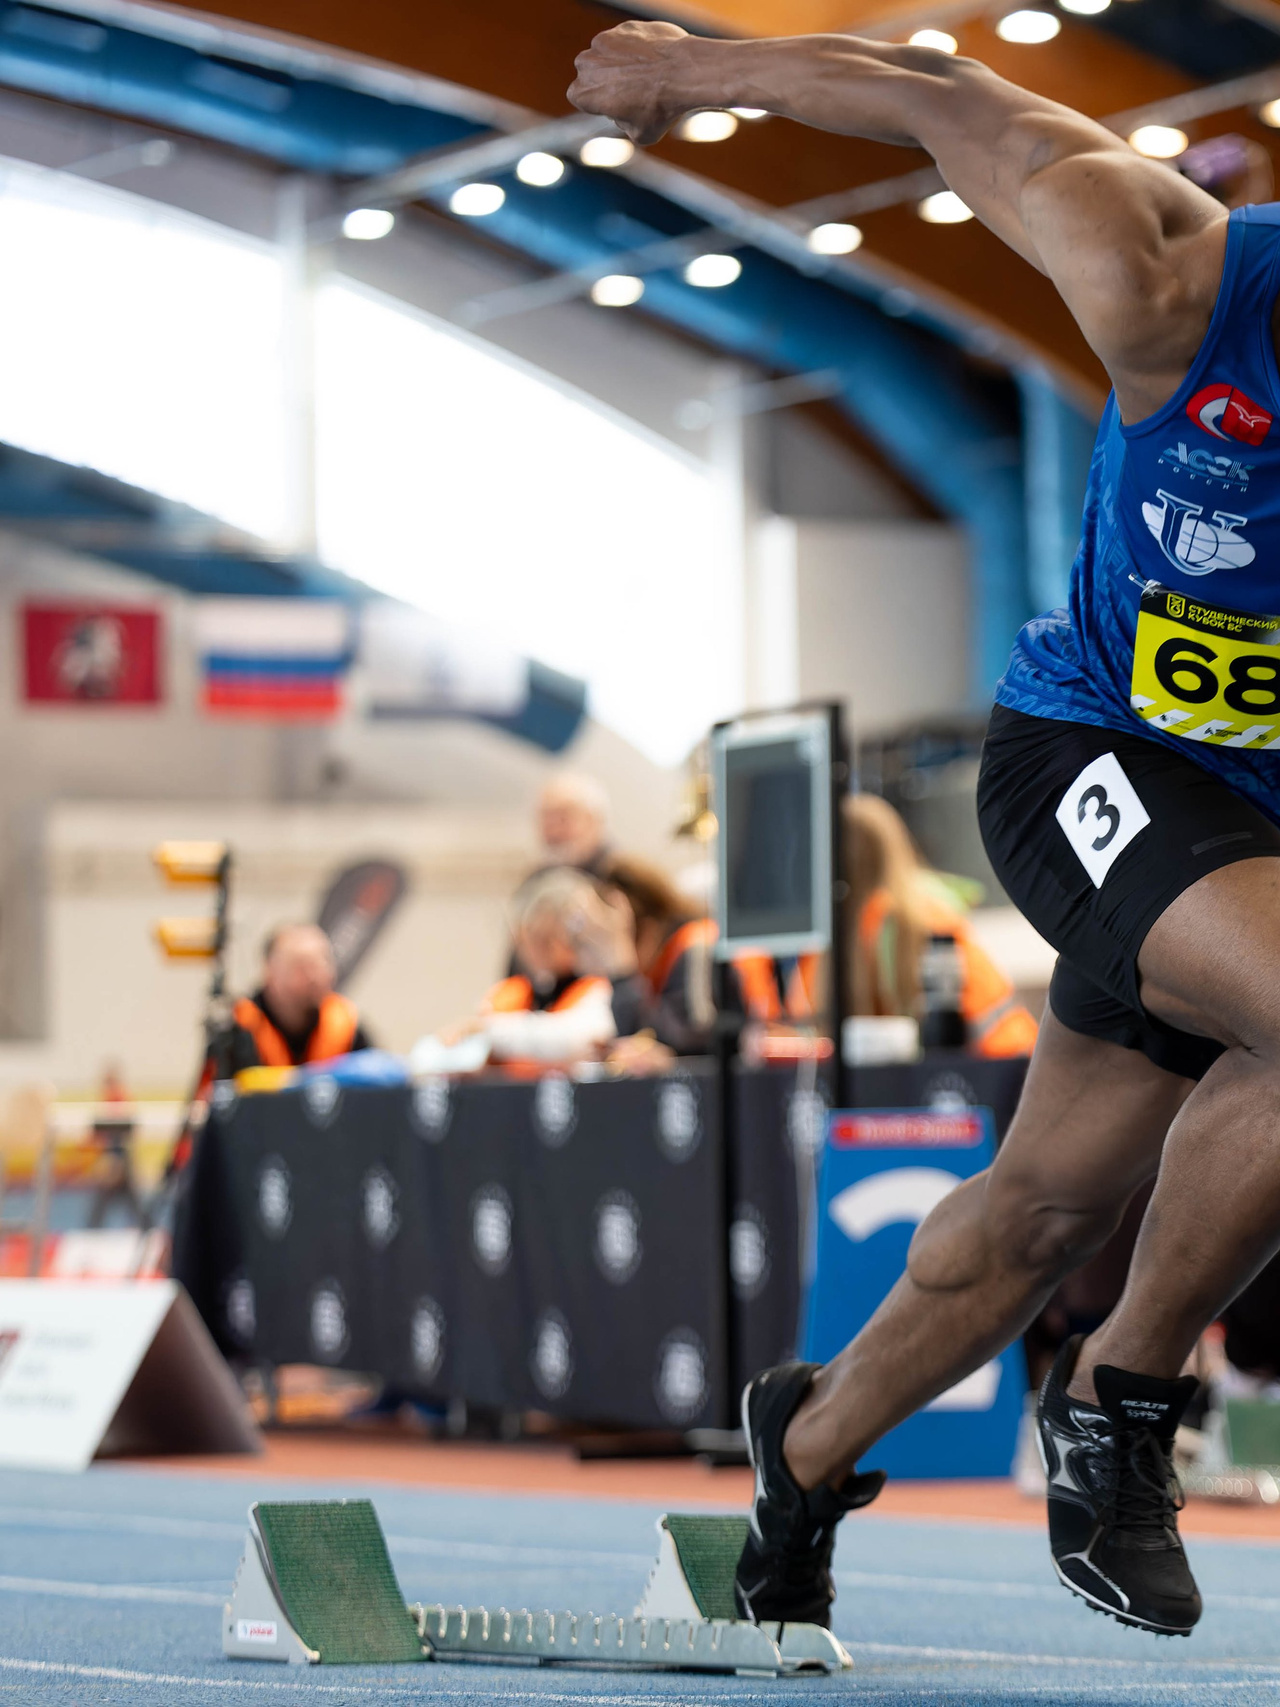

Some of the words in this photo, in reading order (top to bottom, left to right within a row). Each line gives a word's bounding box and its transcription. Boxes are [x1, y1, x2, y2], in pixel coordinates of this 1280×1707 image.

[1187, 612, 1226, 630] КУБОК
[1188, 604, 1279, 630] СТУДЕНЧЕСКИЙ
[1077, 784, 1121, 852] 3
